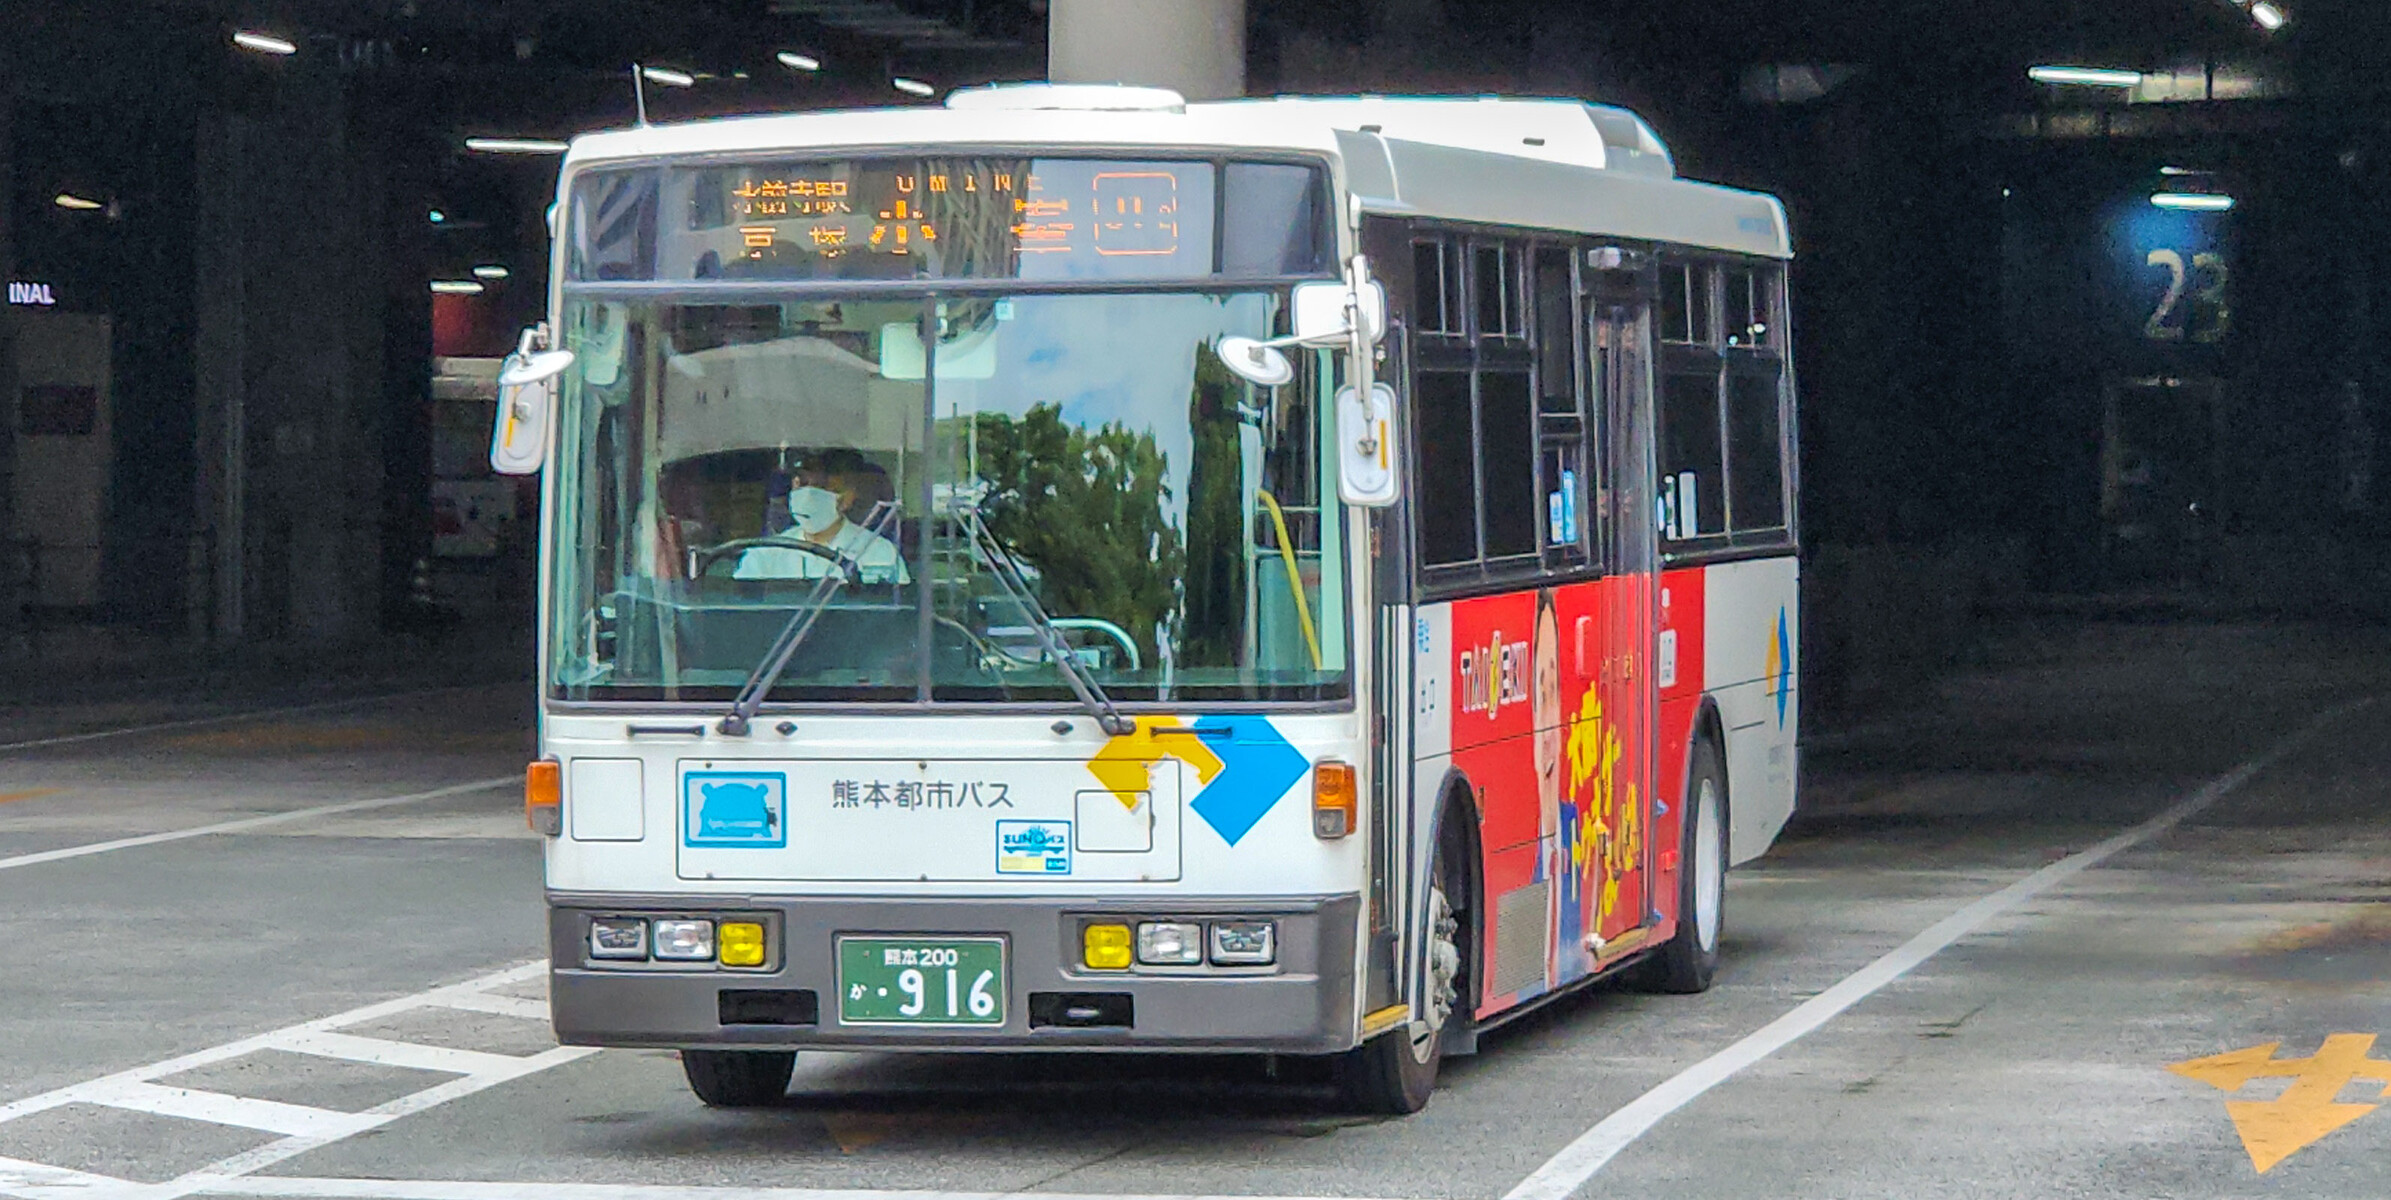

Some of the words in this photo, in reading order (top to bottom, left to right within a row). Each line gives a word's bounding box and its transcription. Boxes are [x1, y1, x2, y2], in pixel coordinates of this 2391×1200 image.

[2145, 248, 2229, 342] 23
[832, 780, 1014, 811] 熊本都市バス
